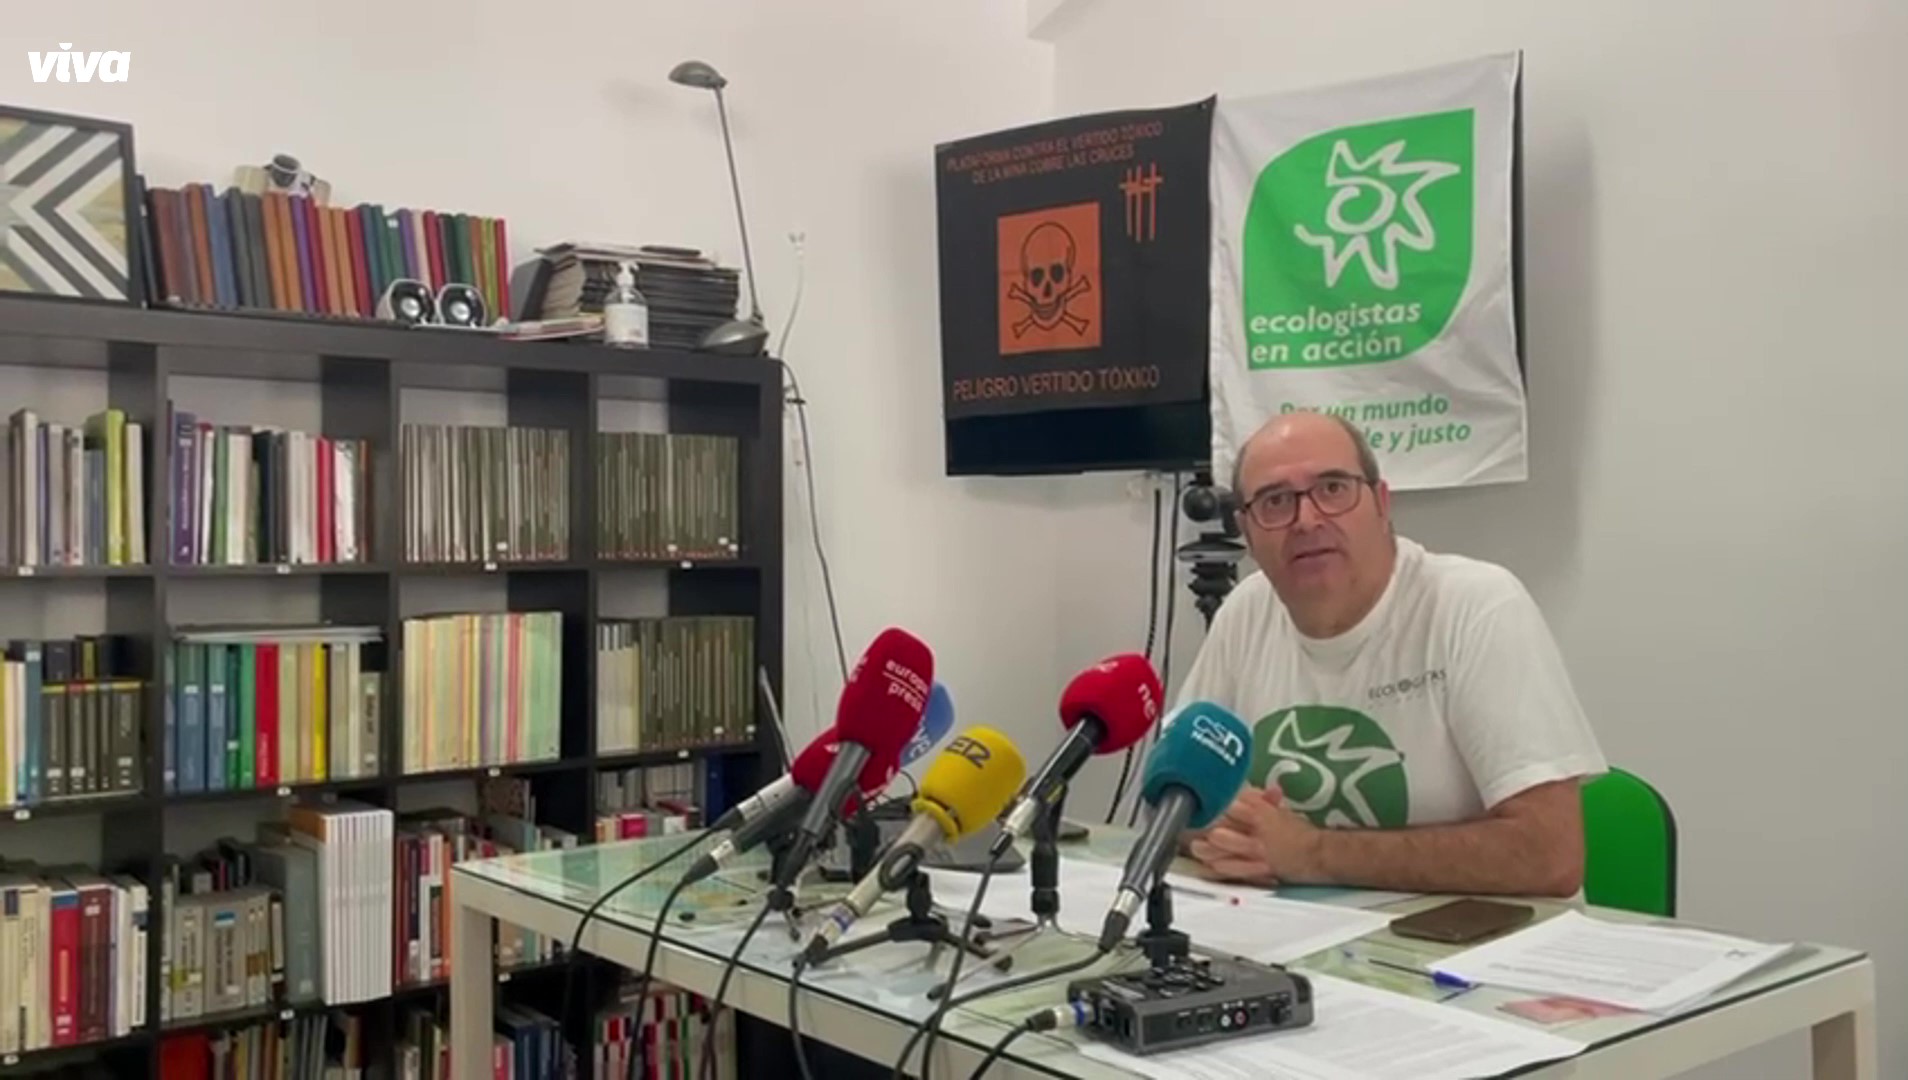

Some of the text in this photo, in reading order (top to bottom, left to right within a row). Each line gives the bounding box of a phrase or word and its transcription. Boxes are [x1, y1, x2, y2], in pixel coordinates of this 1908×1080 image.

[1250, 301, 1421, 337] ecologistas
[1251, 329, 1402, 363] en acción
[953, 375, 1018, 401] PELIGRO
[1020, 370, 1094, 395] VERTIDO
[1362, 393, 1448, 421] mundo
[1389, 429, 1403, 452] y
[1406, 423, 1471, 452] justo
